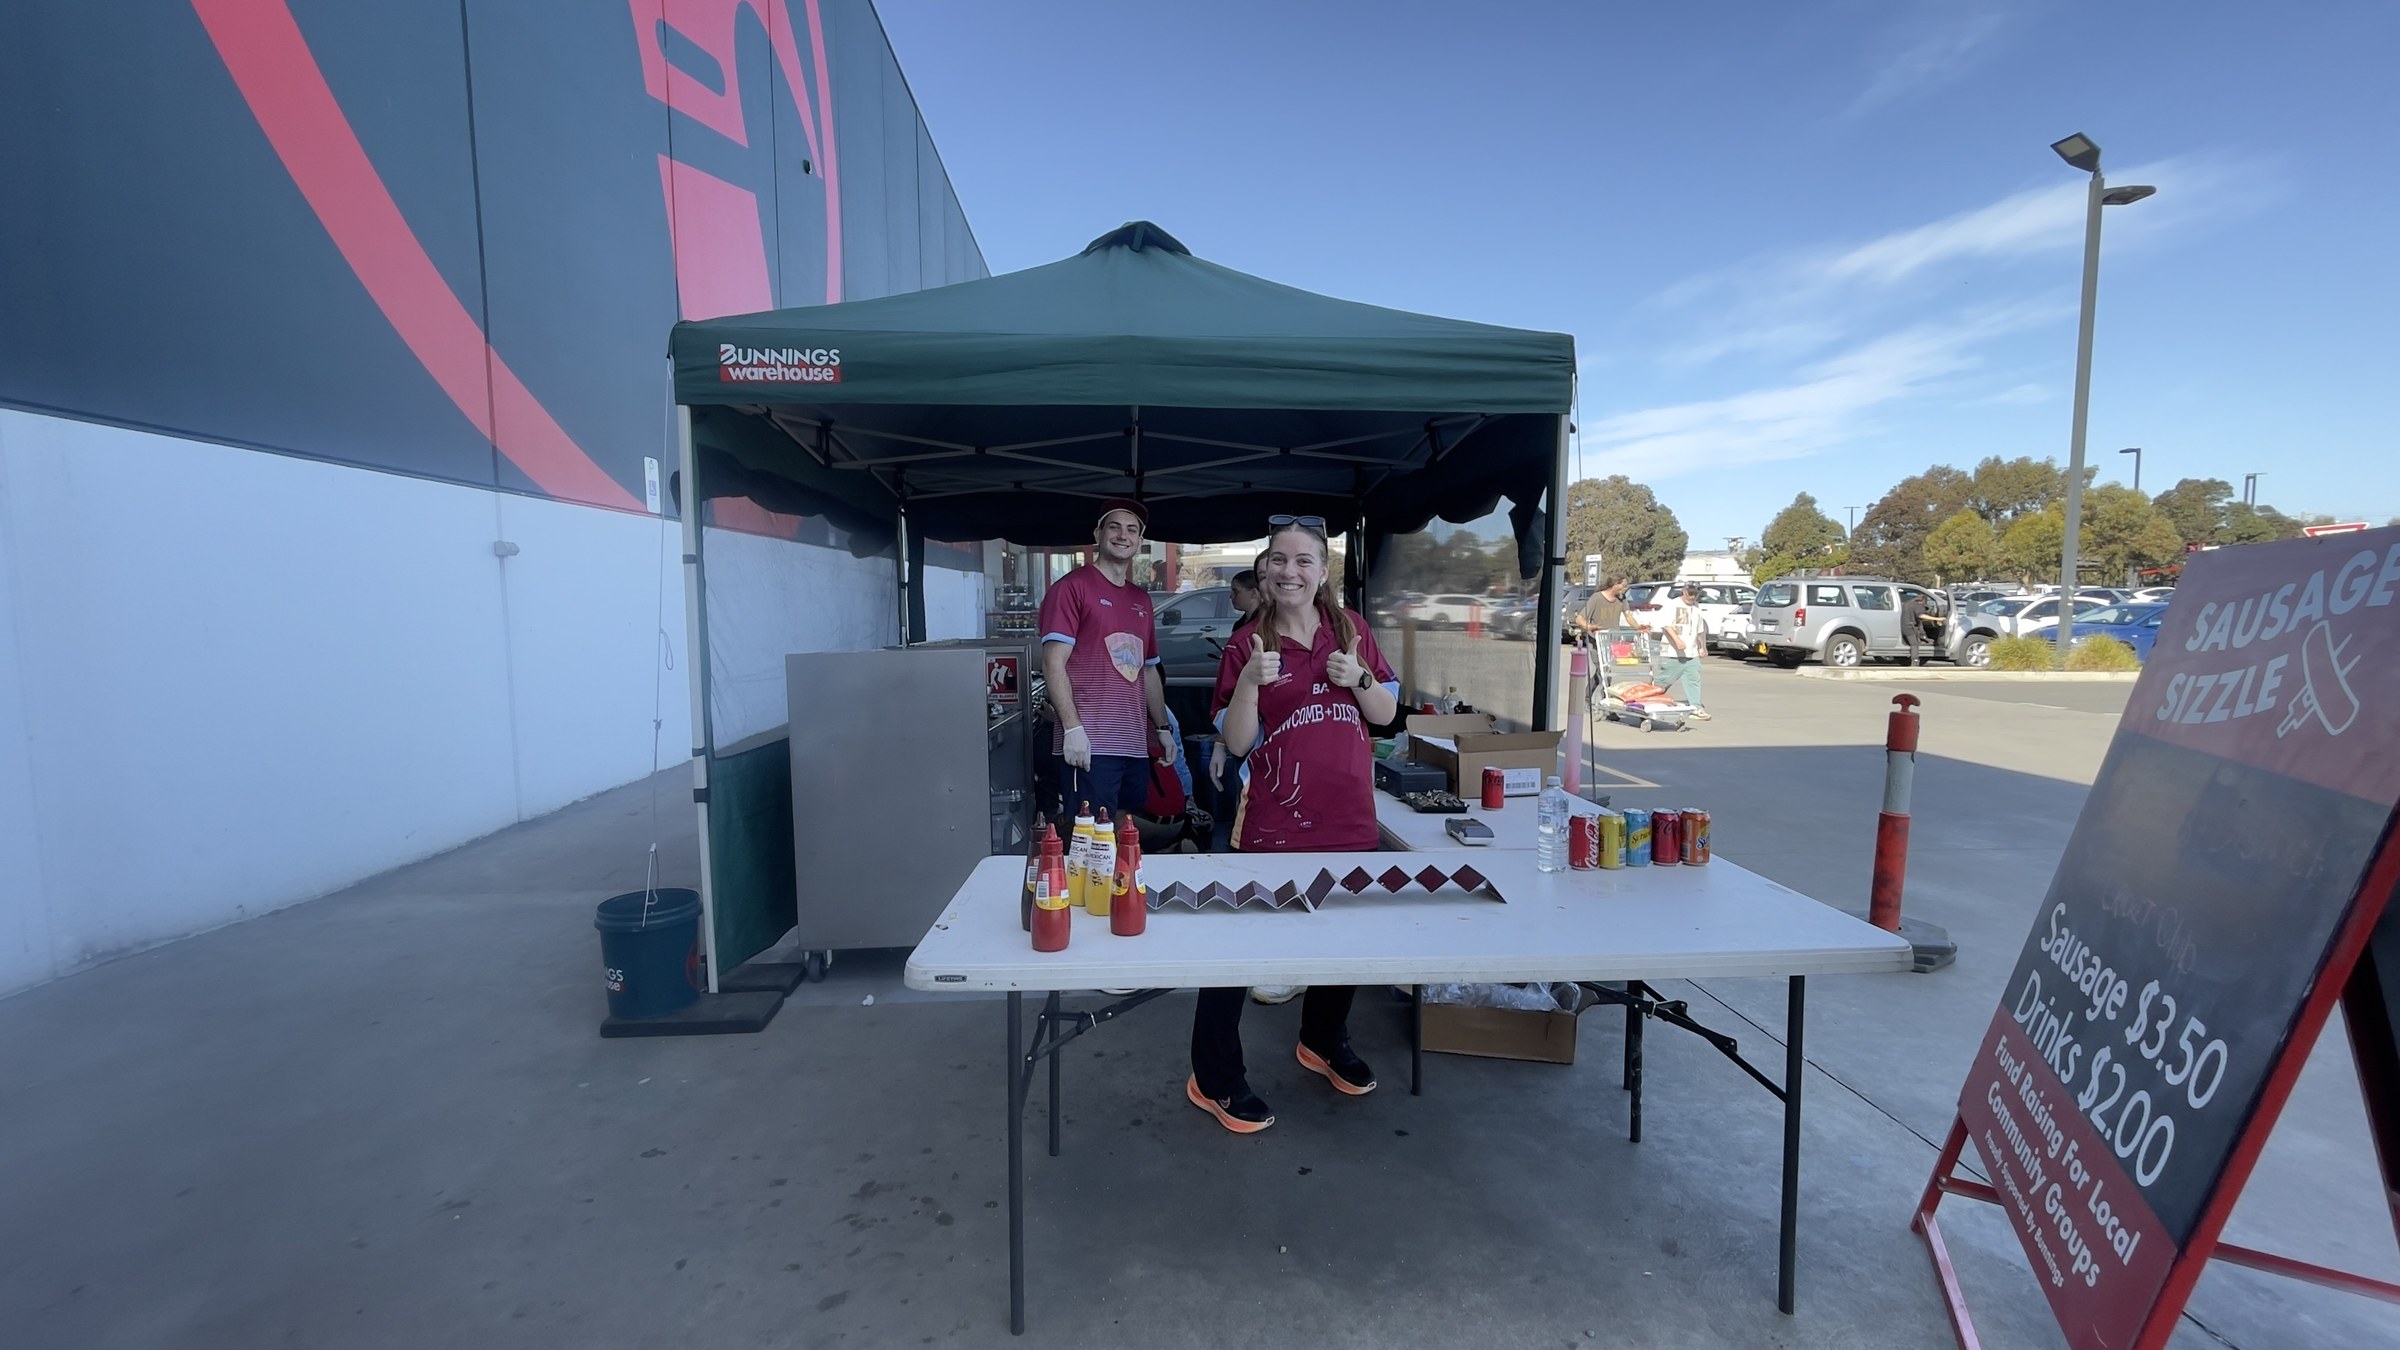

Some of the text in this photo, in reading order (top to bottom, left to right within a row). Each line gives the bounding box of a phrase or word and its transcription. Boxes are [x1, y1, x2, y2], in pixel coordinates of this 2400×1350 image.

[720, 343, 840, 366] BUNNINGS
[728, 361, 835, 381] warehouse
[2185, 543, 2400, 652] SAUSAGE
[2156, 653, 2290, 725] SIZZLE
[2012, 969, 2175, 1187] Drinks $2.00
[2040, 902, 2228, 1109] Sausage $3.50
[1984, 1128, 2064, 1289] Proudly Supported By Bunnings
[1987, 1080, 2100, 1288] Community Groups
[1994, 1035, 2141, 1267] Fund Raising For Local
